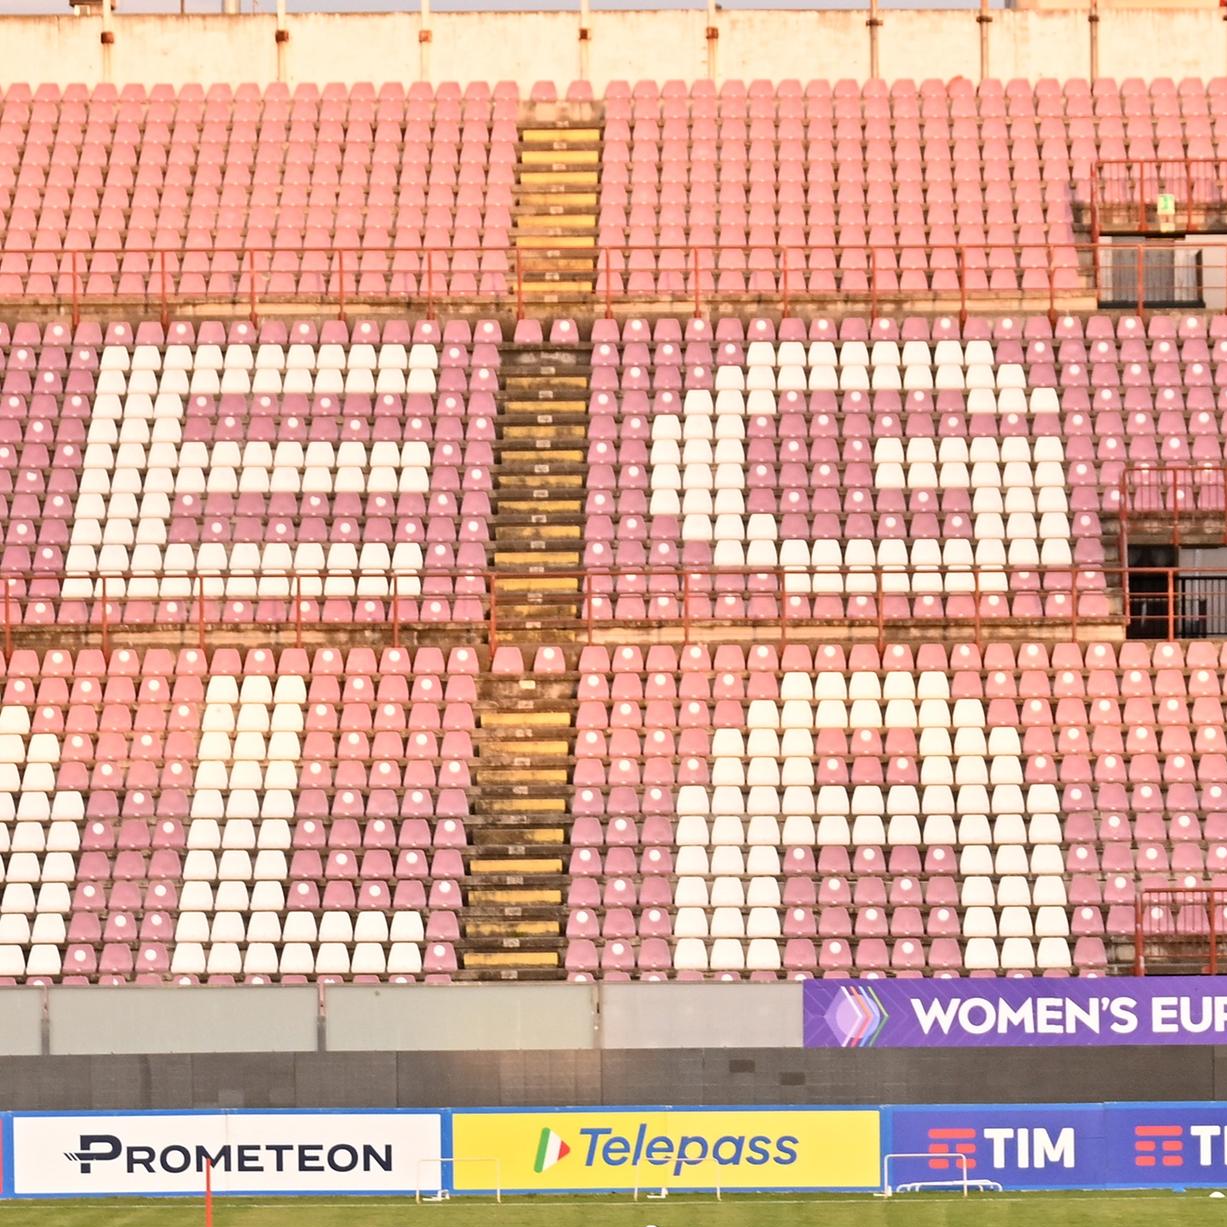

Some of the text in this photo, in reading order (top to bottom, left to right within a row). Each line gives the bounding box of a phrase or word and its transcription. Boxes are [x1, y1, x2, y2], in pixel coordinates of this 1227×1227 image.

[910, 996, 1138, 1035] WOMEN'S
[66, 1134, 393, 1174] PROMETEON
[579, 1123, 799, 1176] Telepass
[983, 1127, 1076, 1168] TIM
